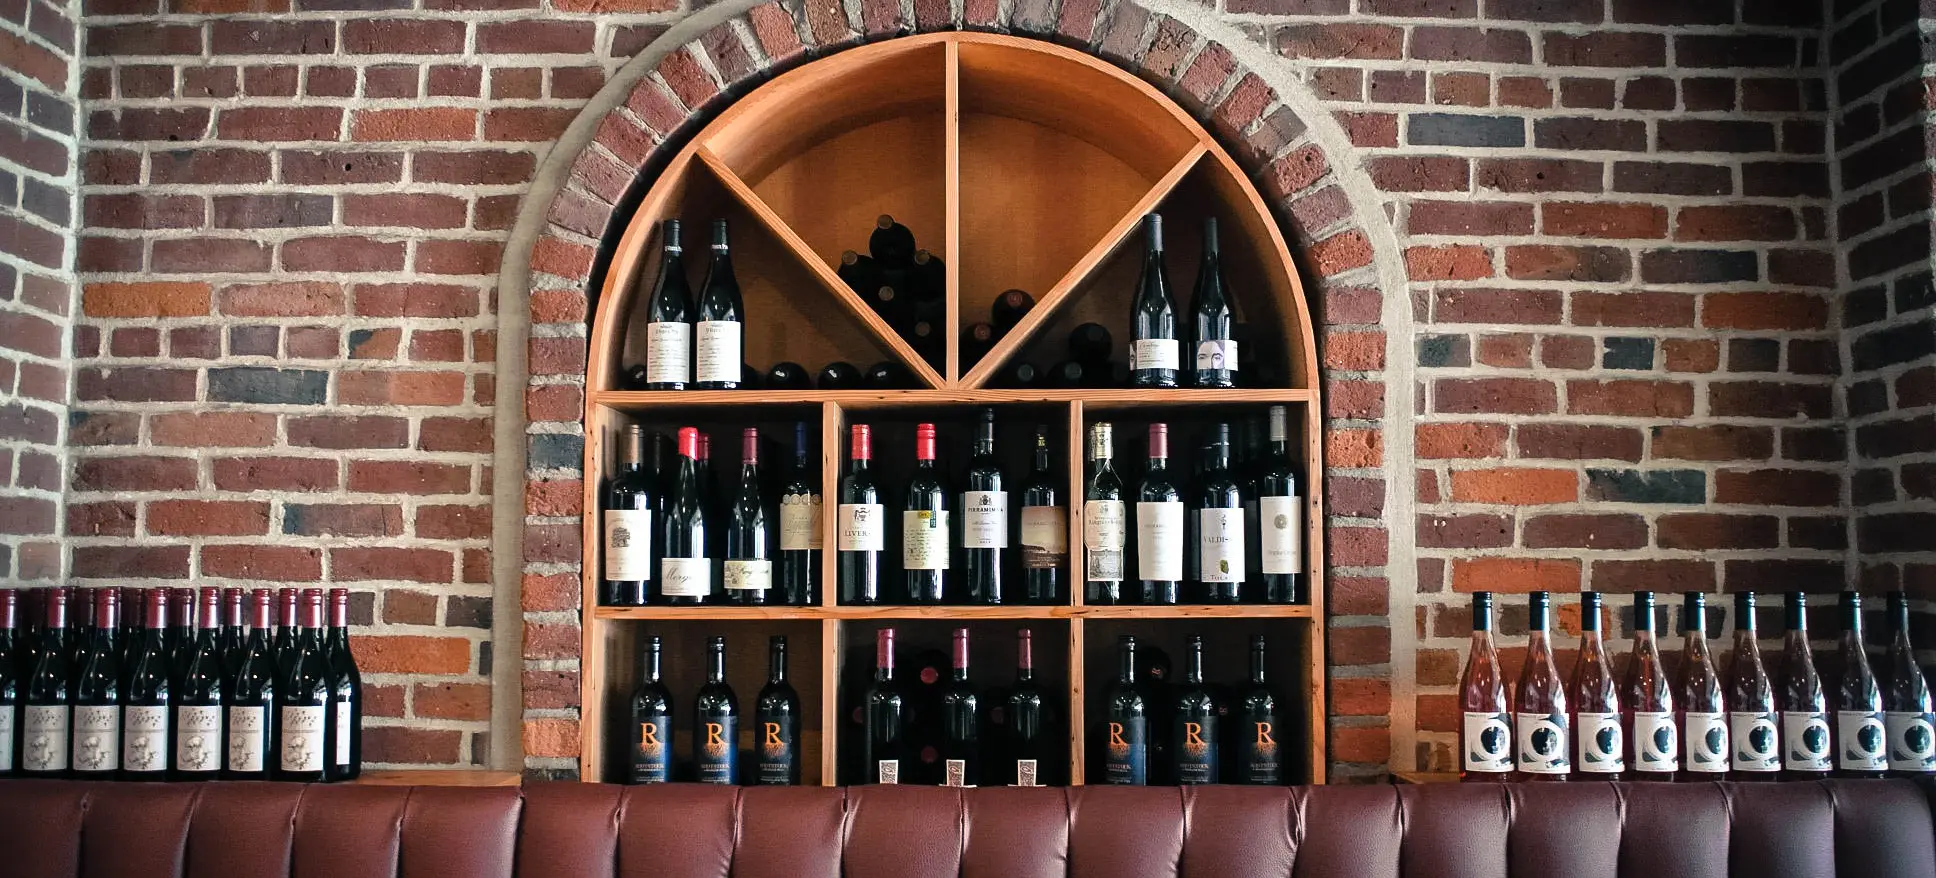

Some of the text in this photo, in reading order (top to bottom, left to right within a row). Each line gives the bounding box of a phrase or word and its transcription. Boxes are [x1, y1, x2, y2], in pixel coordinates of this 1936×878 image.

[666, 567, 691, 584] Morg
[640, 722, 661, 744] R
[705, 722, 727, 744] R
[764, 722, 784, 744] R
[1109, 722, 1128, 744] R
[1184, 722, 1205, 744] R
[1255, 722, 1275, 744] R
